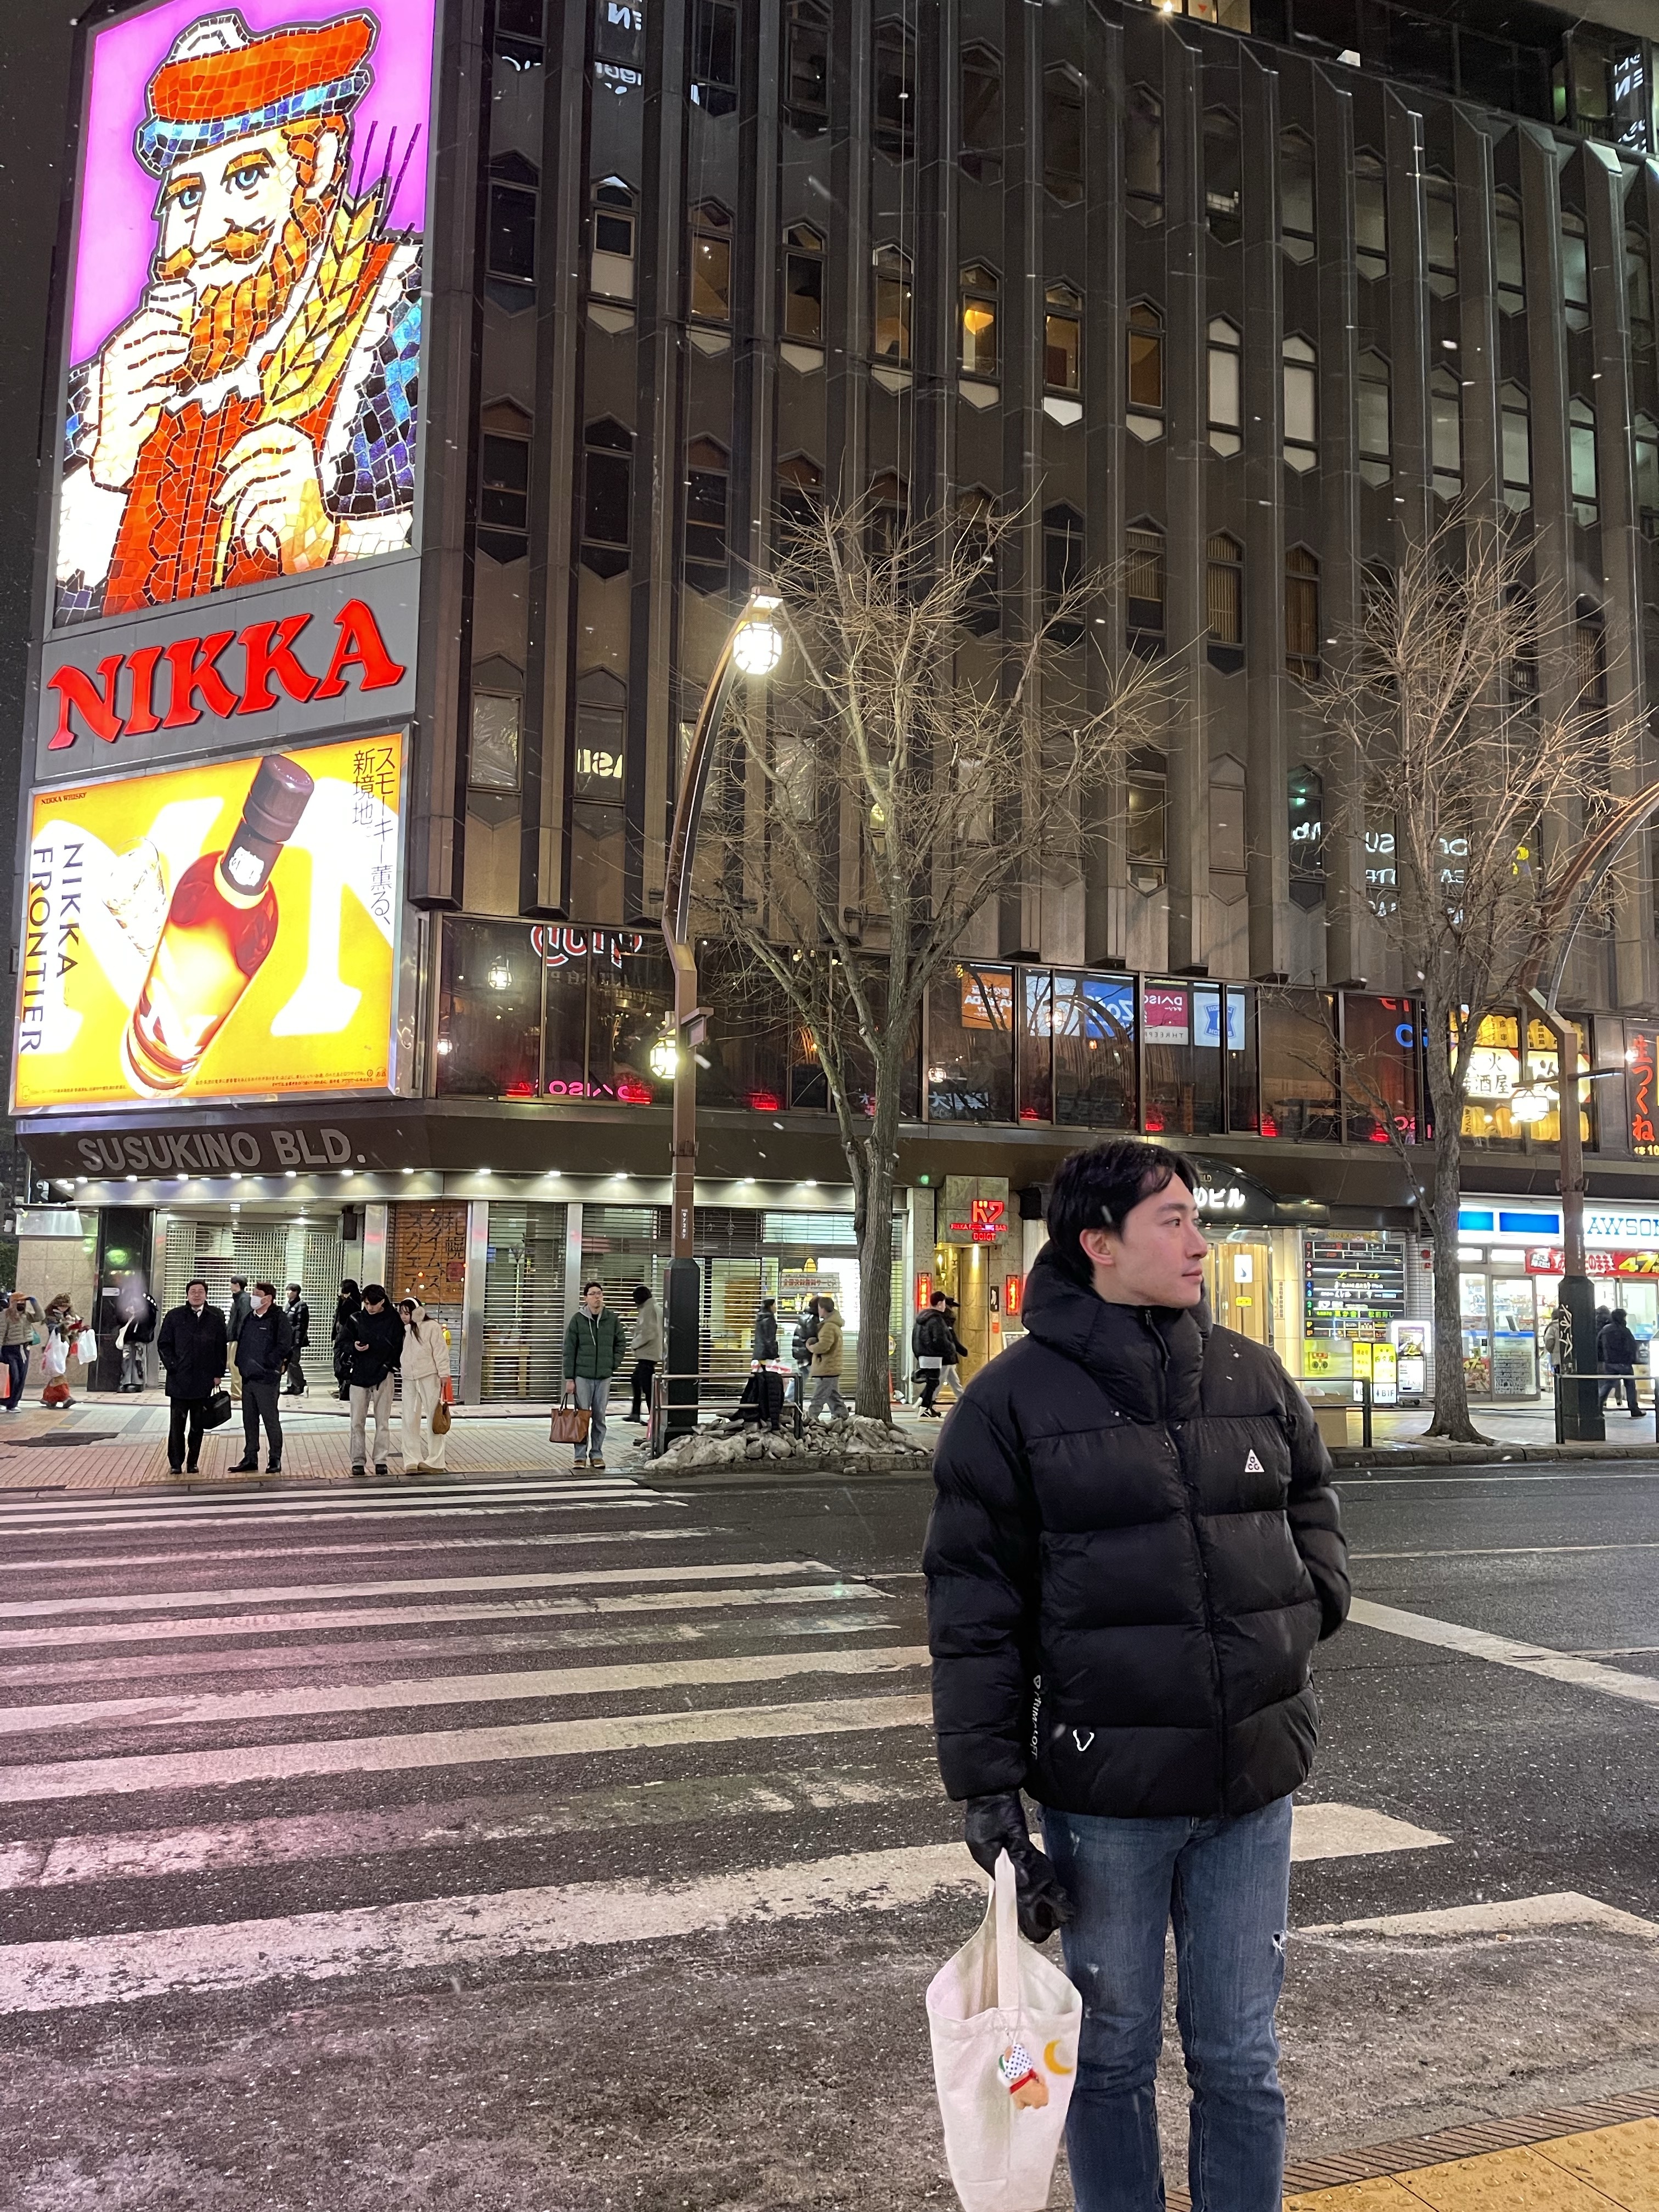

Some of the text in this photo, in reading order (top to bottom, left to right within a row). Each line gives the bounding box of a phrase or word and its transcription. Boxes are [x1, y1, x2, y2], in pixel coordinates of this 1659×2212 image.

[48, 599, 406, 751] NIKKA
[20, 847, 53, 1054] FRONTIER
[56, 843, 84, 978] NIKKA
[78, 1129, 366, 1171] SUSUKINO BLD.
[445, 1212, 466, 1260] 札幌
[973, 1232, 996, 1241] DOIGT
